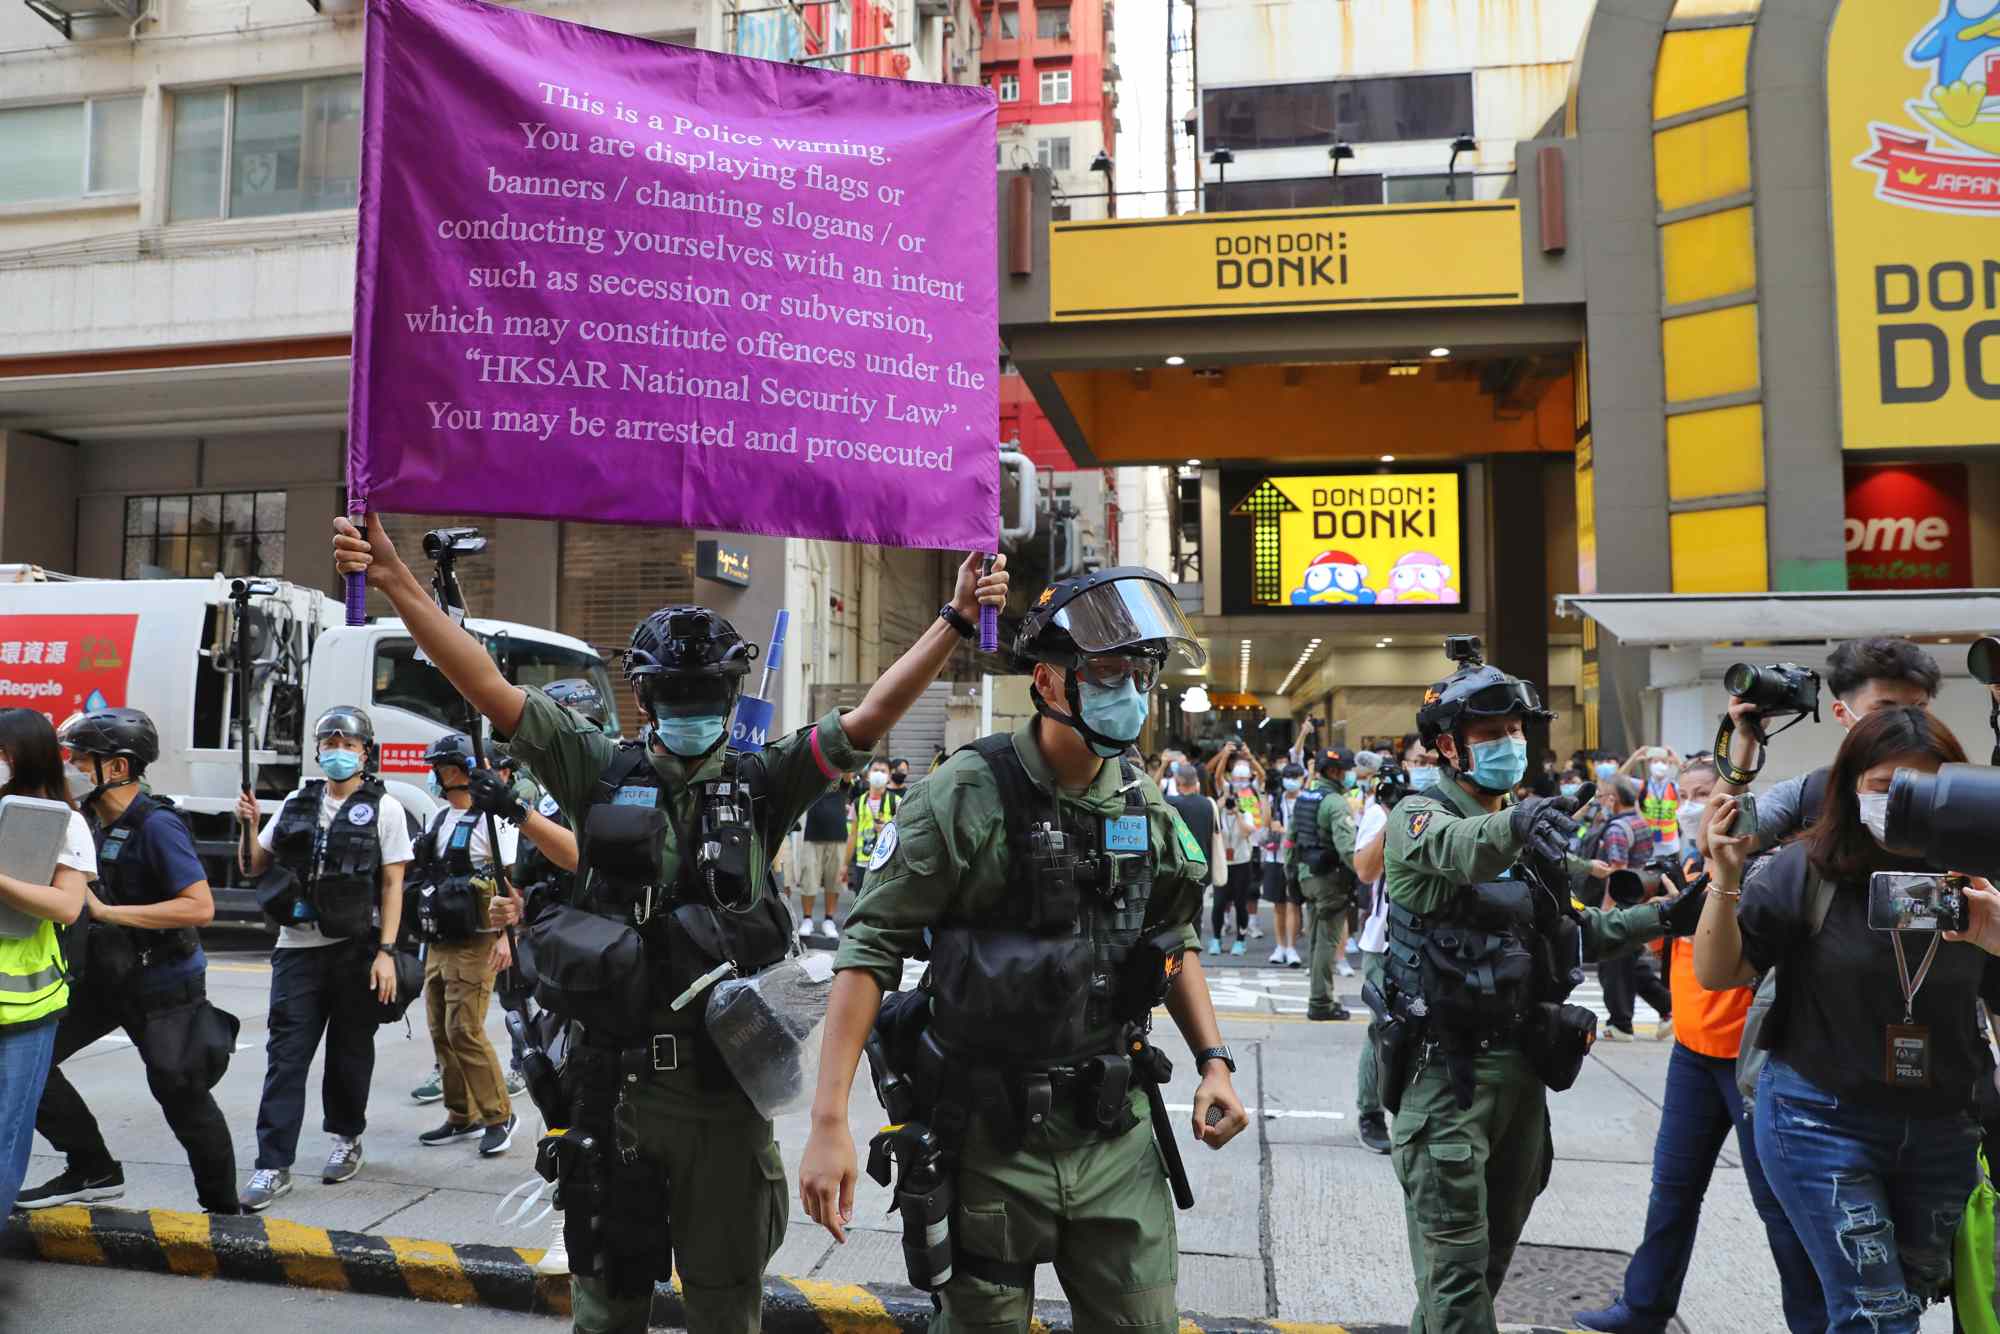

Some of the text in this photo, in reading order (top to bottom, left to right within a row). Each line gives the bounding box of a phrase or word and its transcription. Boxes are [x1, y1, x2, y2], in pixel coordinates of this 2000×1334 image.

[519, 122, 905, 207] You are displaying flags or
[538, 82, 892, 166] This is a Police warning.
[487, 165, 926, 253] banners / chanting slogans / or
[437, 212, 965, 302] conducting yourselves with an intent
[468, 260, 933, 344] such as secession or subversion,
[404, 304, 985, 390] which may constitute offences under the
[619, 363, 750, 402] National
[760, 377, 878, 423] Security
[426, 401, 953, 472] You may be arrested and prosecuted
[1896, 1069, 1923, 1078] PRESS
